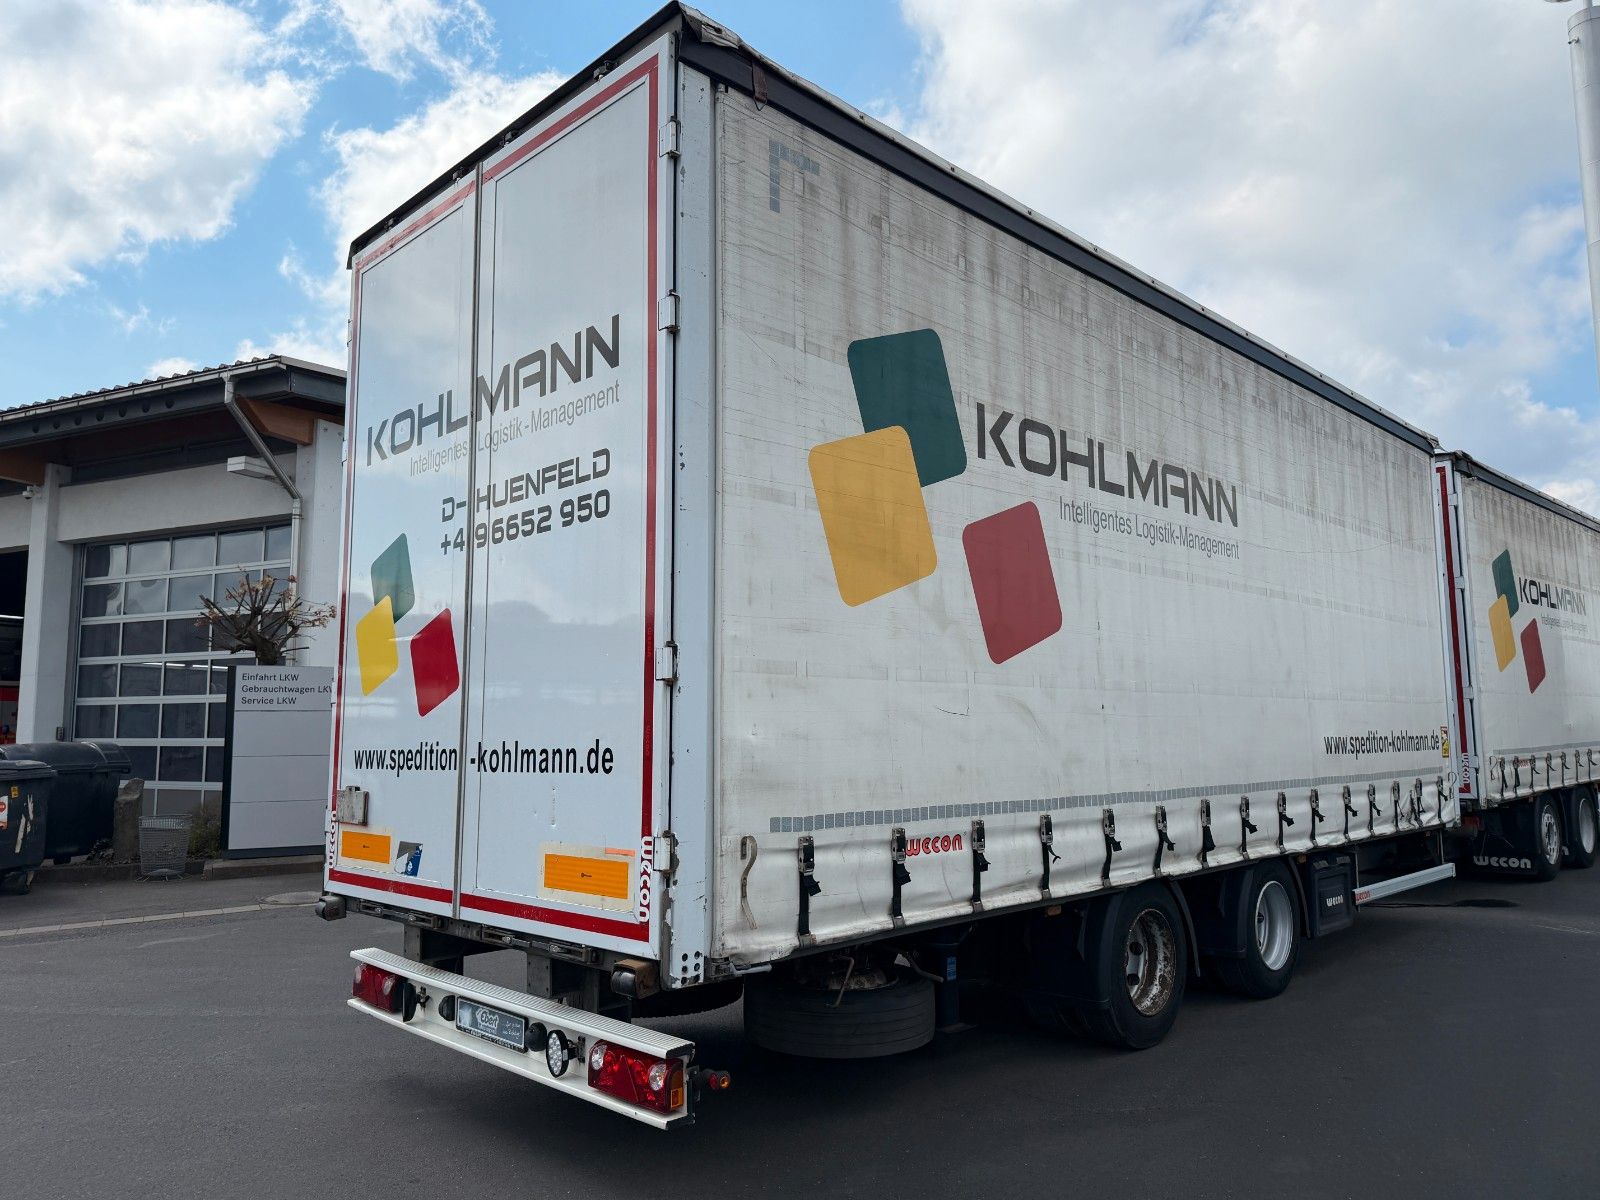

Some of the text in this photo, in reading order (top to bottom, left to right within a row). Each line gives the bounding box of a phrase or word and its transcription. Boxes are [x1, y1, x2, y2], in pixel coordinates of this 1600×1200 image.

[367, 314, 620, 466] KOHLMANN
[410, 379, 620, 477] Intelligentes Logistik-Management
[976, 402, 1238, 527] KOHLMANN
[559, 489, 610, 528] 950
[1059, 496, 1240, 559] Intelligentes Logistik-Management
[1518, 577, 1587, 616] KOHLMANN
[241, 685, 315, 694] Gebrauchtwagen
[242, 673, 300, 682] Einfahrt LKW
[241, 697, 297, 705] Service LKW
[1323, 730, 1440, 760] www.spedition-kohlmann.de
[905, 834, 963, 857] wecon
[1473, 855, 1532, 869] wecon
[640, 836, 653, 922] wecon
